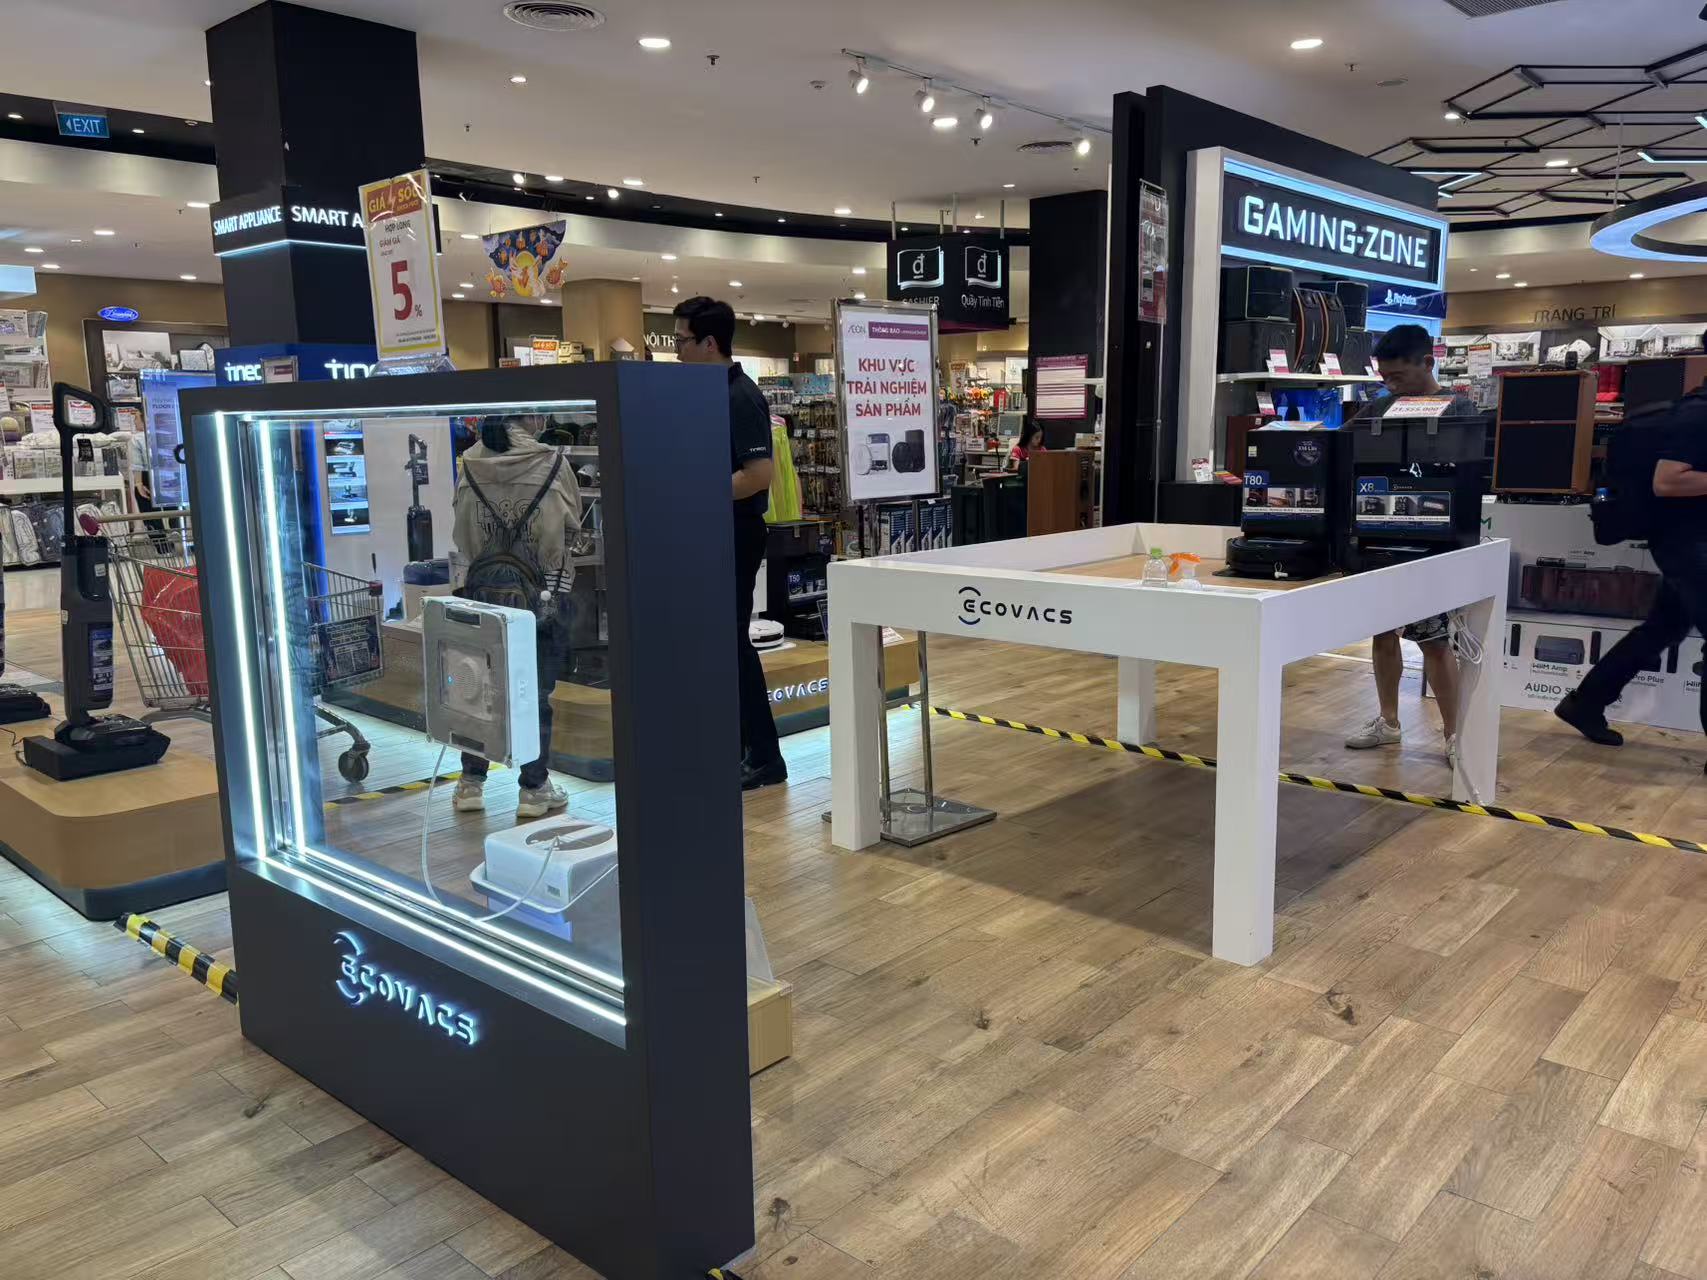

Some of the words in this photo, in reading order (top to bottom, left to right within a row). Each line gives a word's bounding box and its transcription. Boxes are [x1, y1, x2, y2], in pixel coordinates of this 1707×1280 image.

[73, 119, 100, 133] EXIT
[369, 192, 386, 213] GIÁ
[213, 215, 239, 236] SMART
[239, 205, 282, 230] APPLIANCE
[291, 205, 349, 227] SMART
[1243, 195, 1428, 268] GAMING-ZONE
[1534, 307, 1585, 322] TRANG
[858, 358, 885, 373] KHU
[888, 357, 915, 375] VỰC
[846, 377, 877, 395] TRẢI
[880, 378, 927, 397] NGHIỆM
[856, 399, 882, 417] SẢN
[886, 398, 921, 417] PHẨM
[1244, 475, 1263, 486] T80
[1360, 482, 1374, 493] X8
[961, 593, 1072, 625] ECOVACS
[1525, 682, 1562, 695] AUDIO
[1647, 675, 1665, 684] Plus
[337, 943, 477, 1046] ECOVACS
